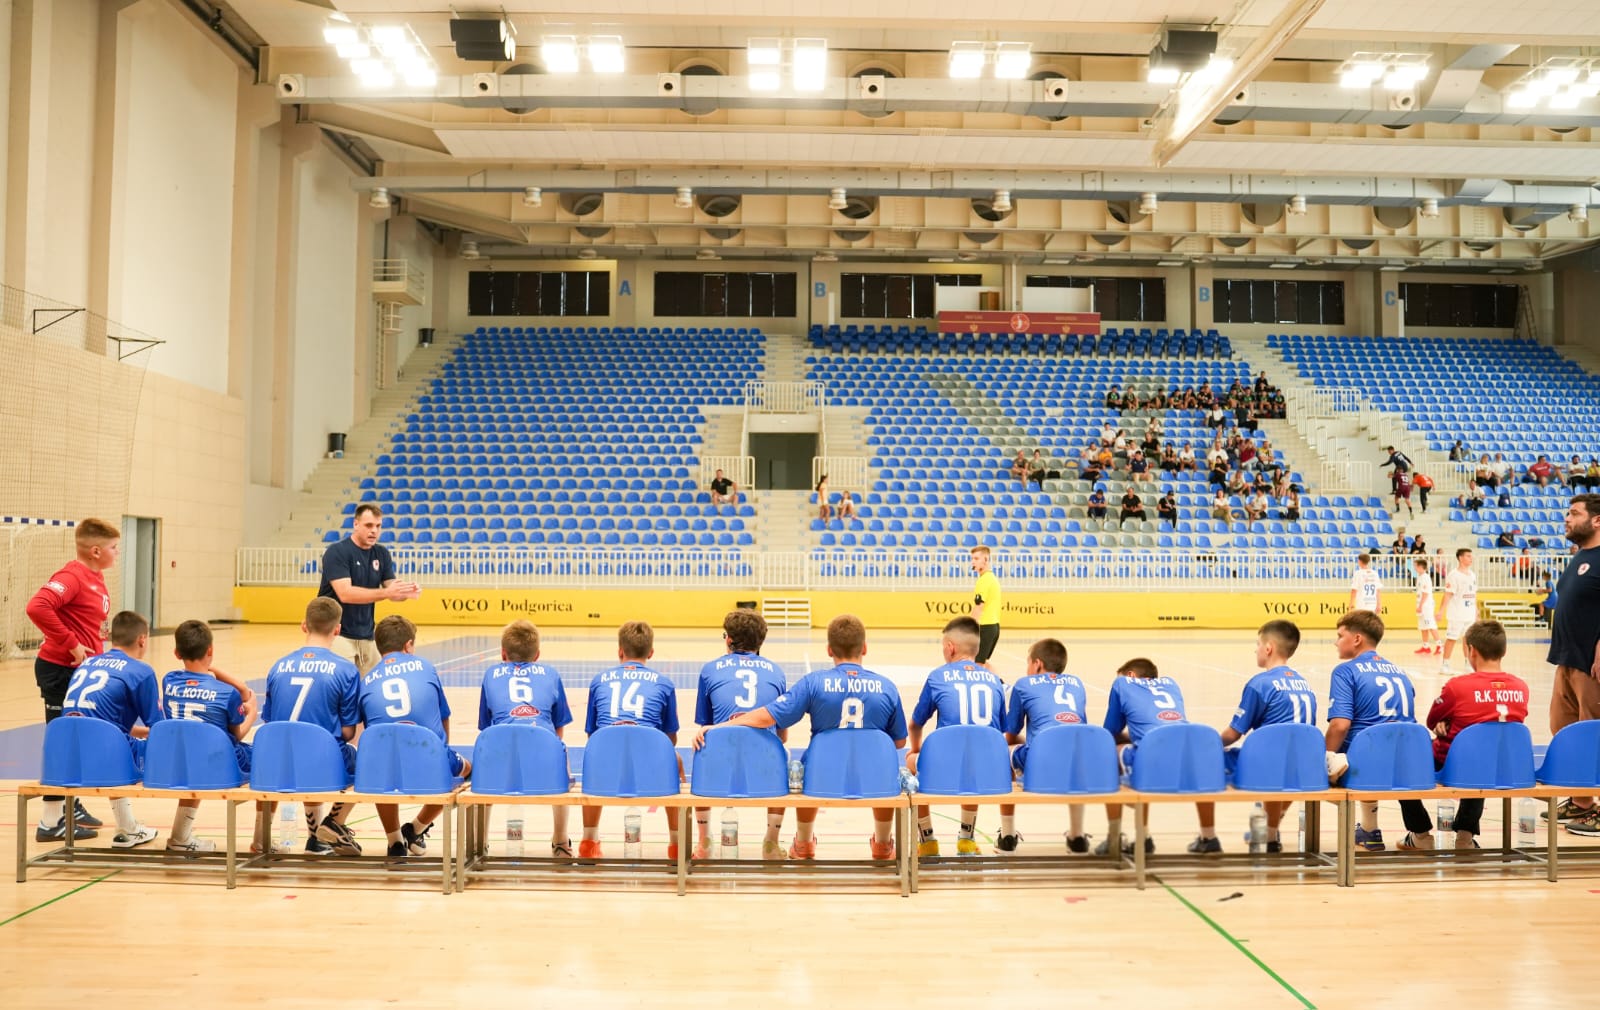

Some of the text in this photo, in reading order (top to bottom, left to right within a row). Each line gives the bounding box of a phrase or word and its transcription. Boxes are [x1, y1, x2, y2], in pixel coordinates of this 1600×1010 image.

[619, 280, 632, 296] A
[815, 282, 826, 297] B
[1199, 287, 1210, 302] B
[1385, 291, 1396, 305] C
[1364, 583, 1376, 596] 99
[441, 598, 573, 615] VOCO Podgorica
[925, 601, 972, 614] VOCO
[1264, 602, 1309, 615] VOCO
[277, 660, 337, 675] R.K. KOTOR
[365, 659, 423, 685] R.K. KOTOR
[493, 666, 510, 679] R.K.
[716, 659, 773, 672] R.K. KOTOR
[601, 670, 659, 683] R.K. KOTOR
[944, 670, 963, 682] R.K.
[63, 669, 110, 710] 22
[165, 683, 217, 701] R.K. KOTOR
[508, 677, 534, 703] 6
[734, 669, 758, 708] 3
[824, 678, 882, 693] R.K. KOTOR
[290, 676, 314, 722] 7
[382, 678, 412, 718] 9
[609, 681, 645, 719] 14
[954, 683, 993, 726] 10
[1054, 685, 1077, 711] 4
[1149, 686, 1176, 709] 5
[1375, 675, 1409, 718] 21
[1474, 690, 1494, 703] R.K.
[1289, 693, 1312, 725] 11
